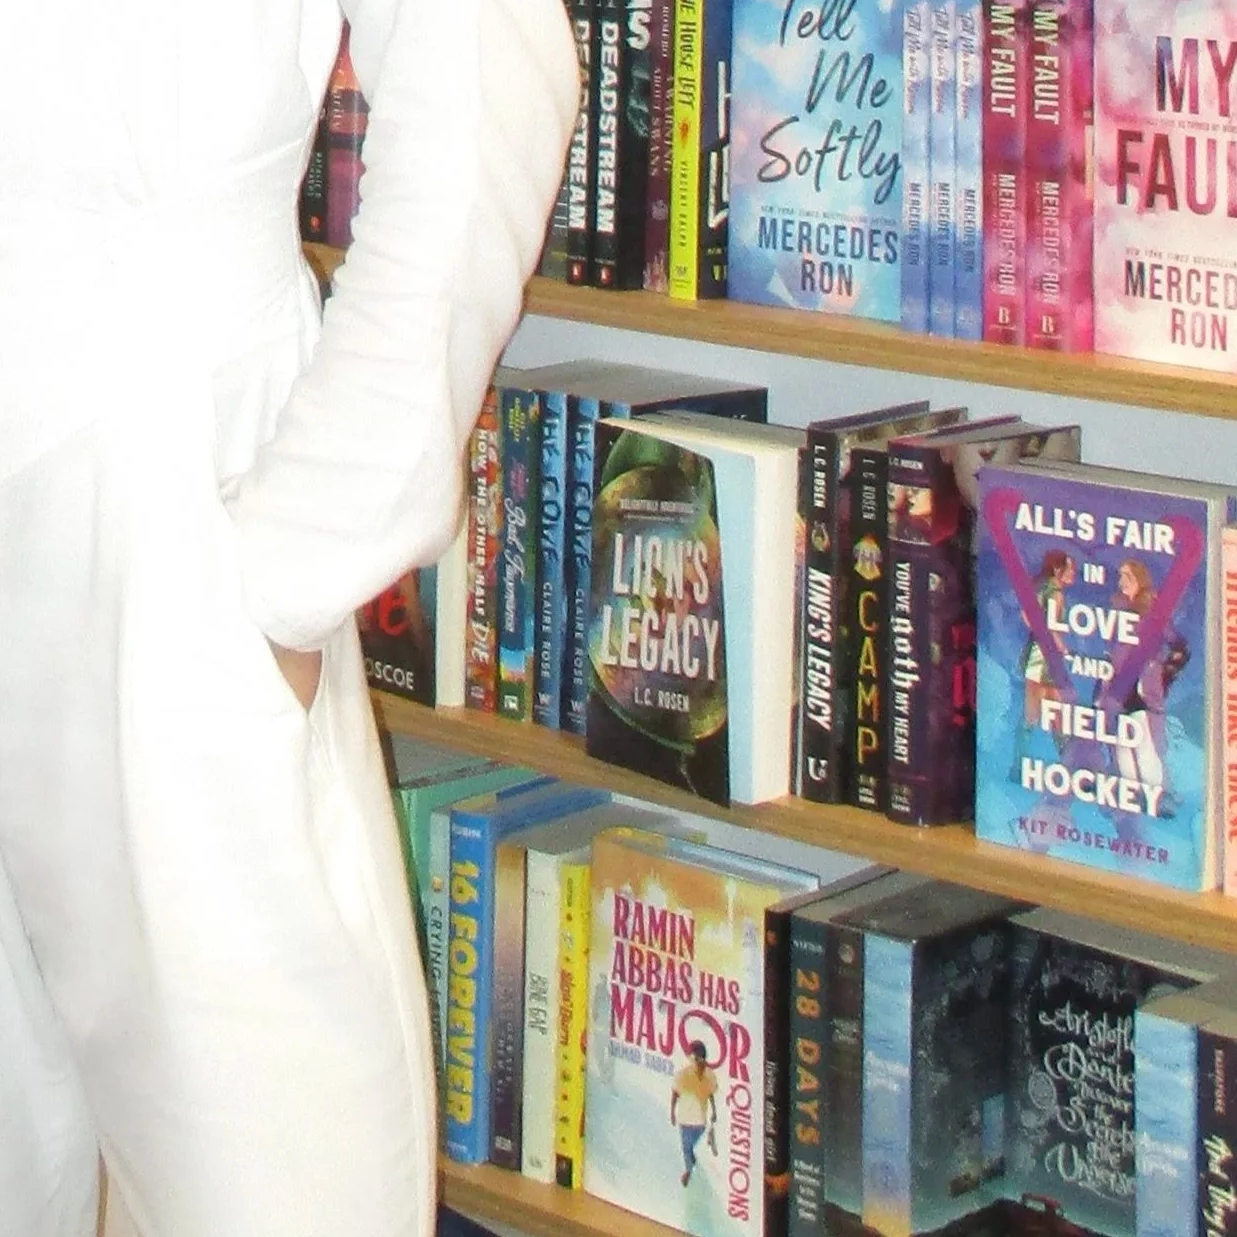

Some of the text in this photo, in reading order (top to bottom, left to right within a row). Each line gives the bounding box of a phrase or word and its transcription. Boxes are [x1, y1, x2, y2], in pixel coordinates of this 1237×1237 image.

[805, 50, 894, 114] Me
[595, 22, 620, 234] DEADSTREAM
[757, 116, 901, 205] Softly
[989, 4, 1017, 296] MY FAULT MERCEDES RON
[758, 216, 898, 263] MERCEDES
[801, 263, 855, 297] RON
[1171, 308, 1228, 352] RON
[1015, 503, 1177, 555] ALL'S FAIR
[612, 532, 711, 605] LION'S
[1082, 563, 1105, 585] IN
[600, 604, 722, 682] LEGACY
[806, 565, 832, 732] KING'S LEGACY
[1046, 604, 1141, 645] LOVE
[857, 590, 881, 765] CAMP
[1071, 657, 1115, 681] AND
[1041, 700, 1149, 749] FIELD
[1021, 758, 1165, 818] HOCKEY
[1018, 816, 1170, 865] KIT ROSEWATER
[613, 892, 696, 962] RAMIN
[446, 861, 481, 1125] 16 FOREVER
[612, 941, 740, 1015] ABBAS HAS
[610, 983, 752, 1084] MAJOR
[795, 968, 821, 1145] 28 DAYS
[725, 1079, 752, 1221] QUESTIONS
